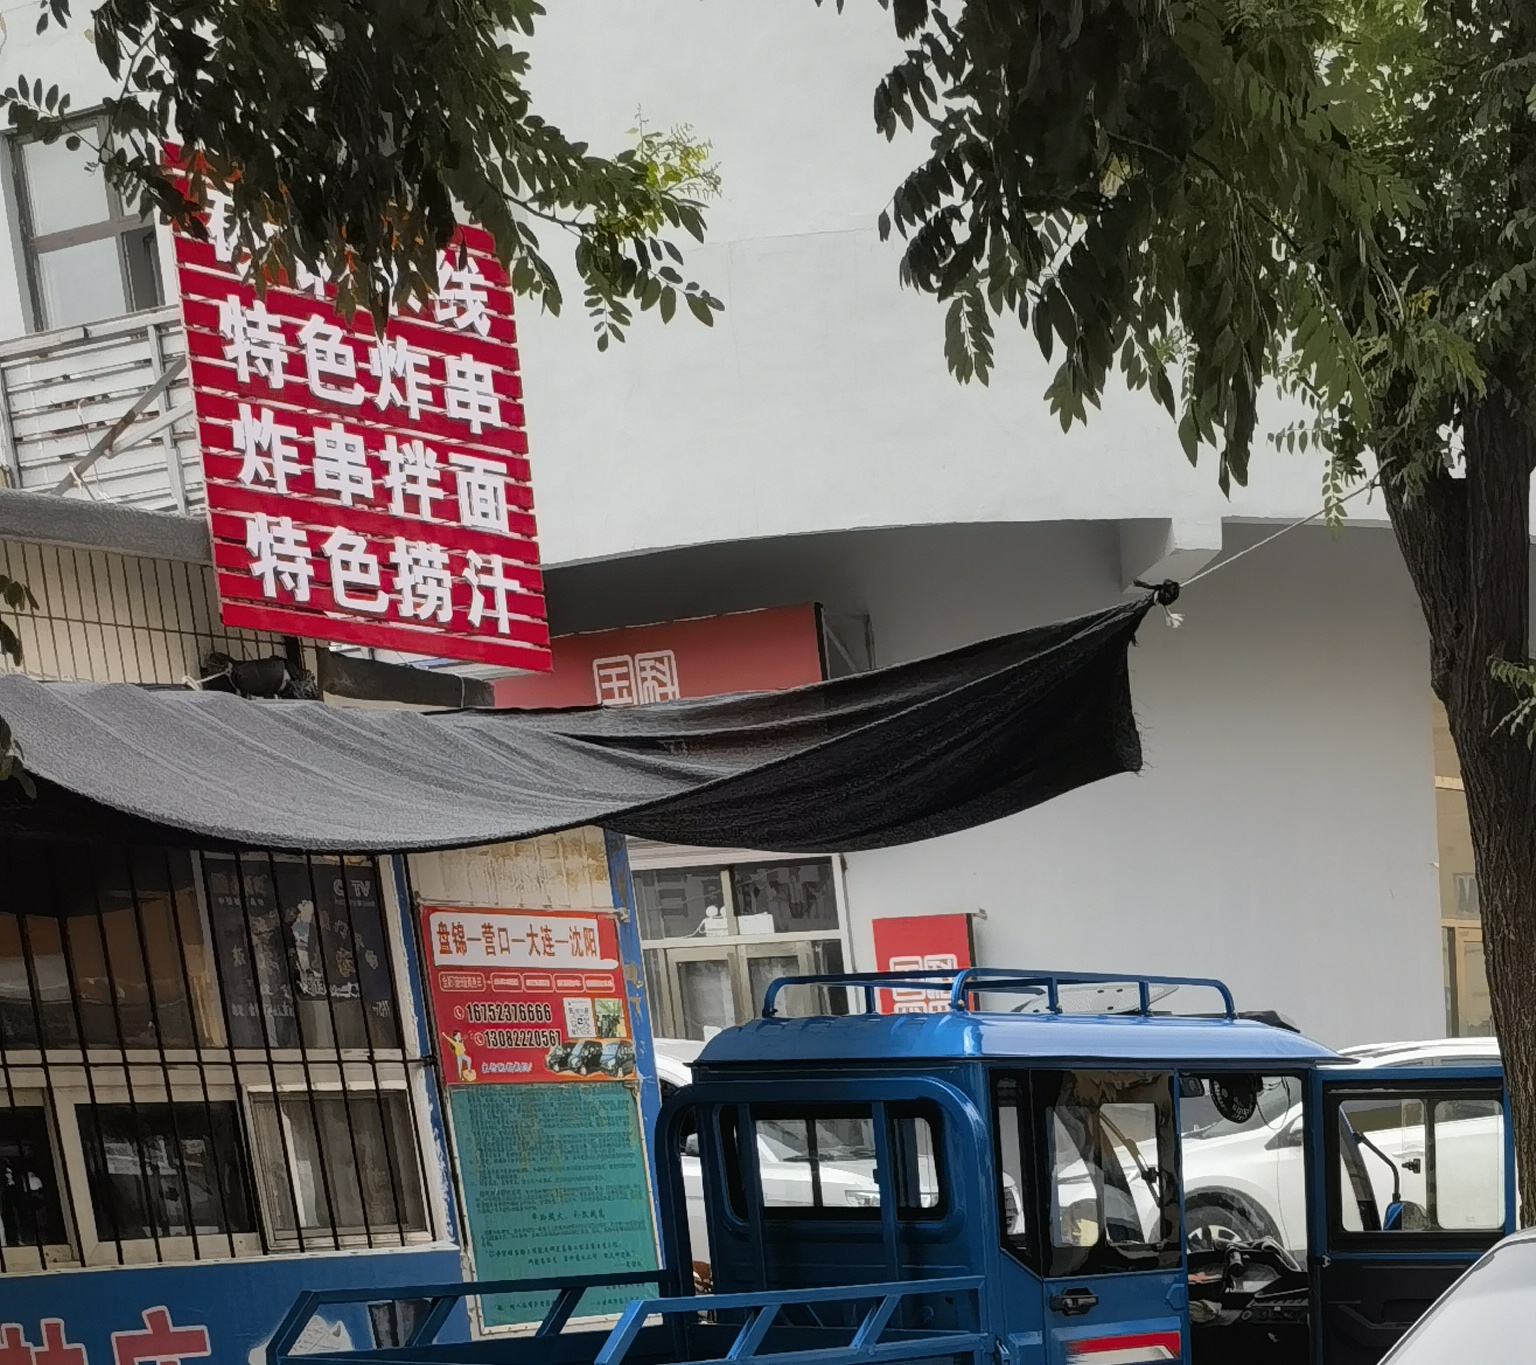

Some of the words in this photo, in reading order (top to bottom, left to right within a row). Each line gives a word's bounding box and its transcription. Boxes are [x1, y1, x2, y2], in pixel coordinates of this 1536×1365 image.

[219, 295, 504, 434] 特色炸串
[232, 403, 510, 534] 炸串拌面
[246, 512, 520, 634] 特色捞汁
